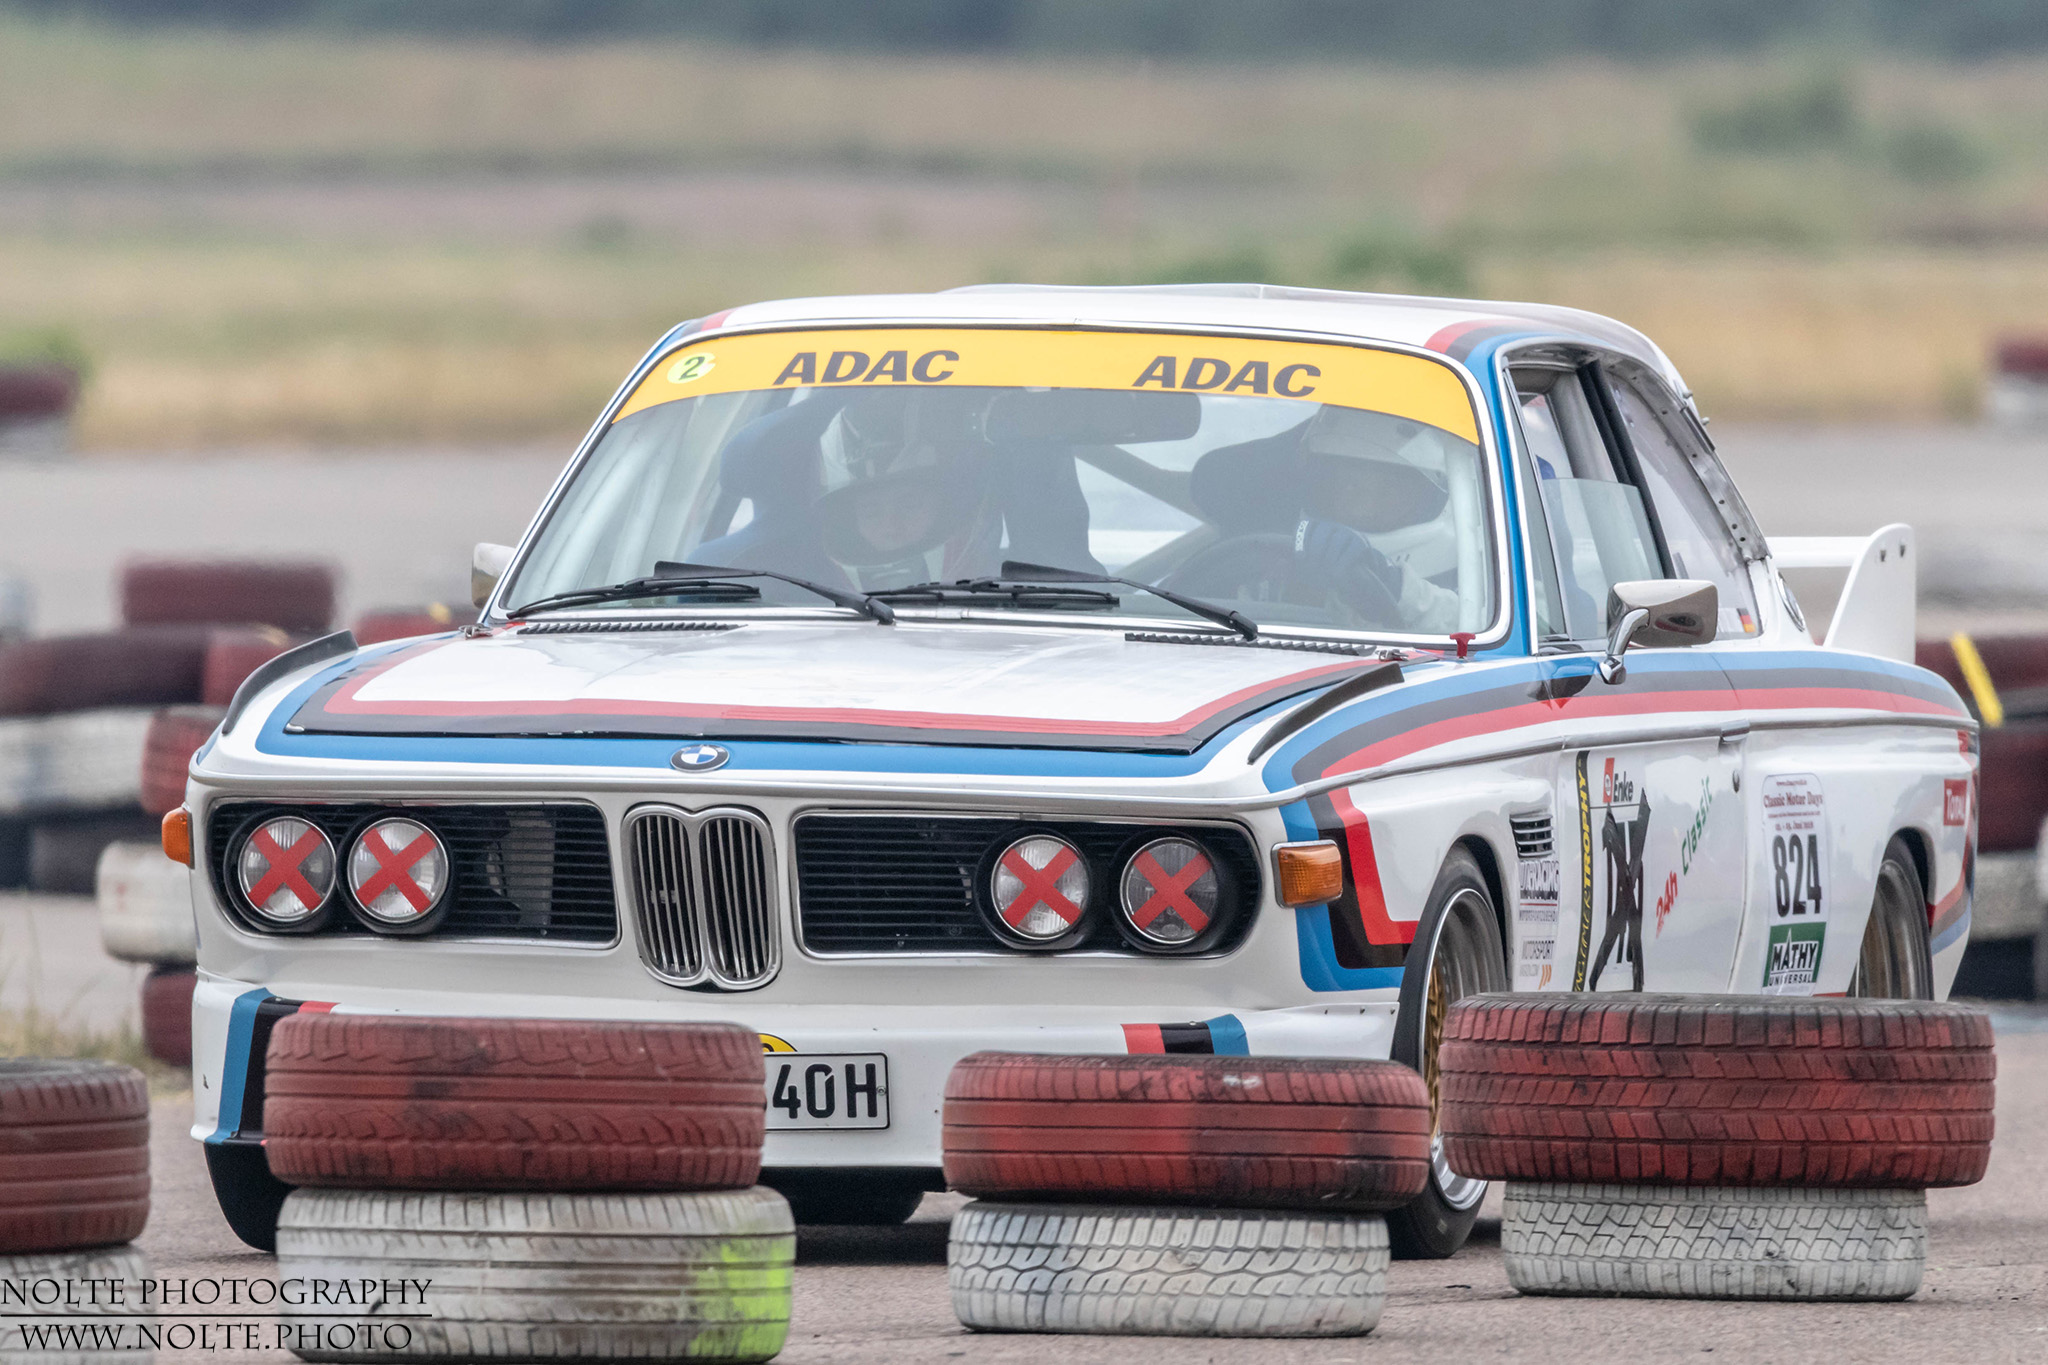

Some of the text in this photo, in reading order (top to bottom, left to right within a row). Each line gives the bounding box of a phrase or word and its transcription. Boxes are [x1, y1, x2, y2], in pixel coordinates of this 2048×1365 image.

[677, 356, 706, 381] 2
[772, 350, 960, 385] ADAC
[1132, 355, 1322, 398] ADAC
[1613, 771, 1634, 802] Enke
[1763, 793, 1785, 808] Classic
[1786, 791, 1806, 806] Motor
[1682, 775, 1713, 876] Classic
[1772, 834, 1822, 917] 824
[1771, 940, 1818, 971] MATHY
[1768, 972, 1813, 987] UNIVERSAL
[772, 1063, 878, 1119] 40H
